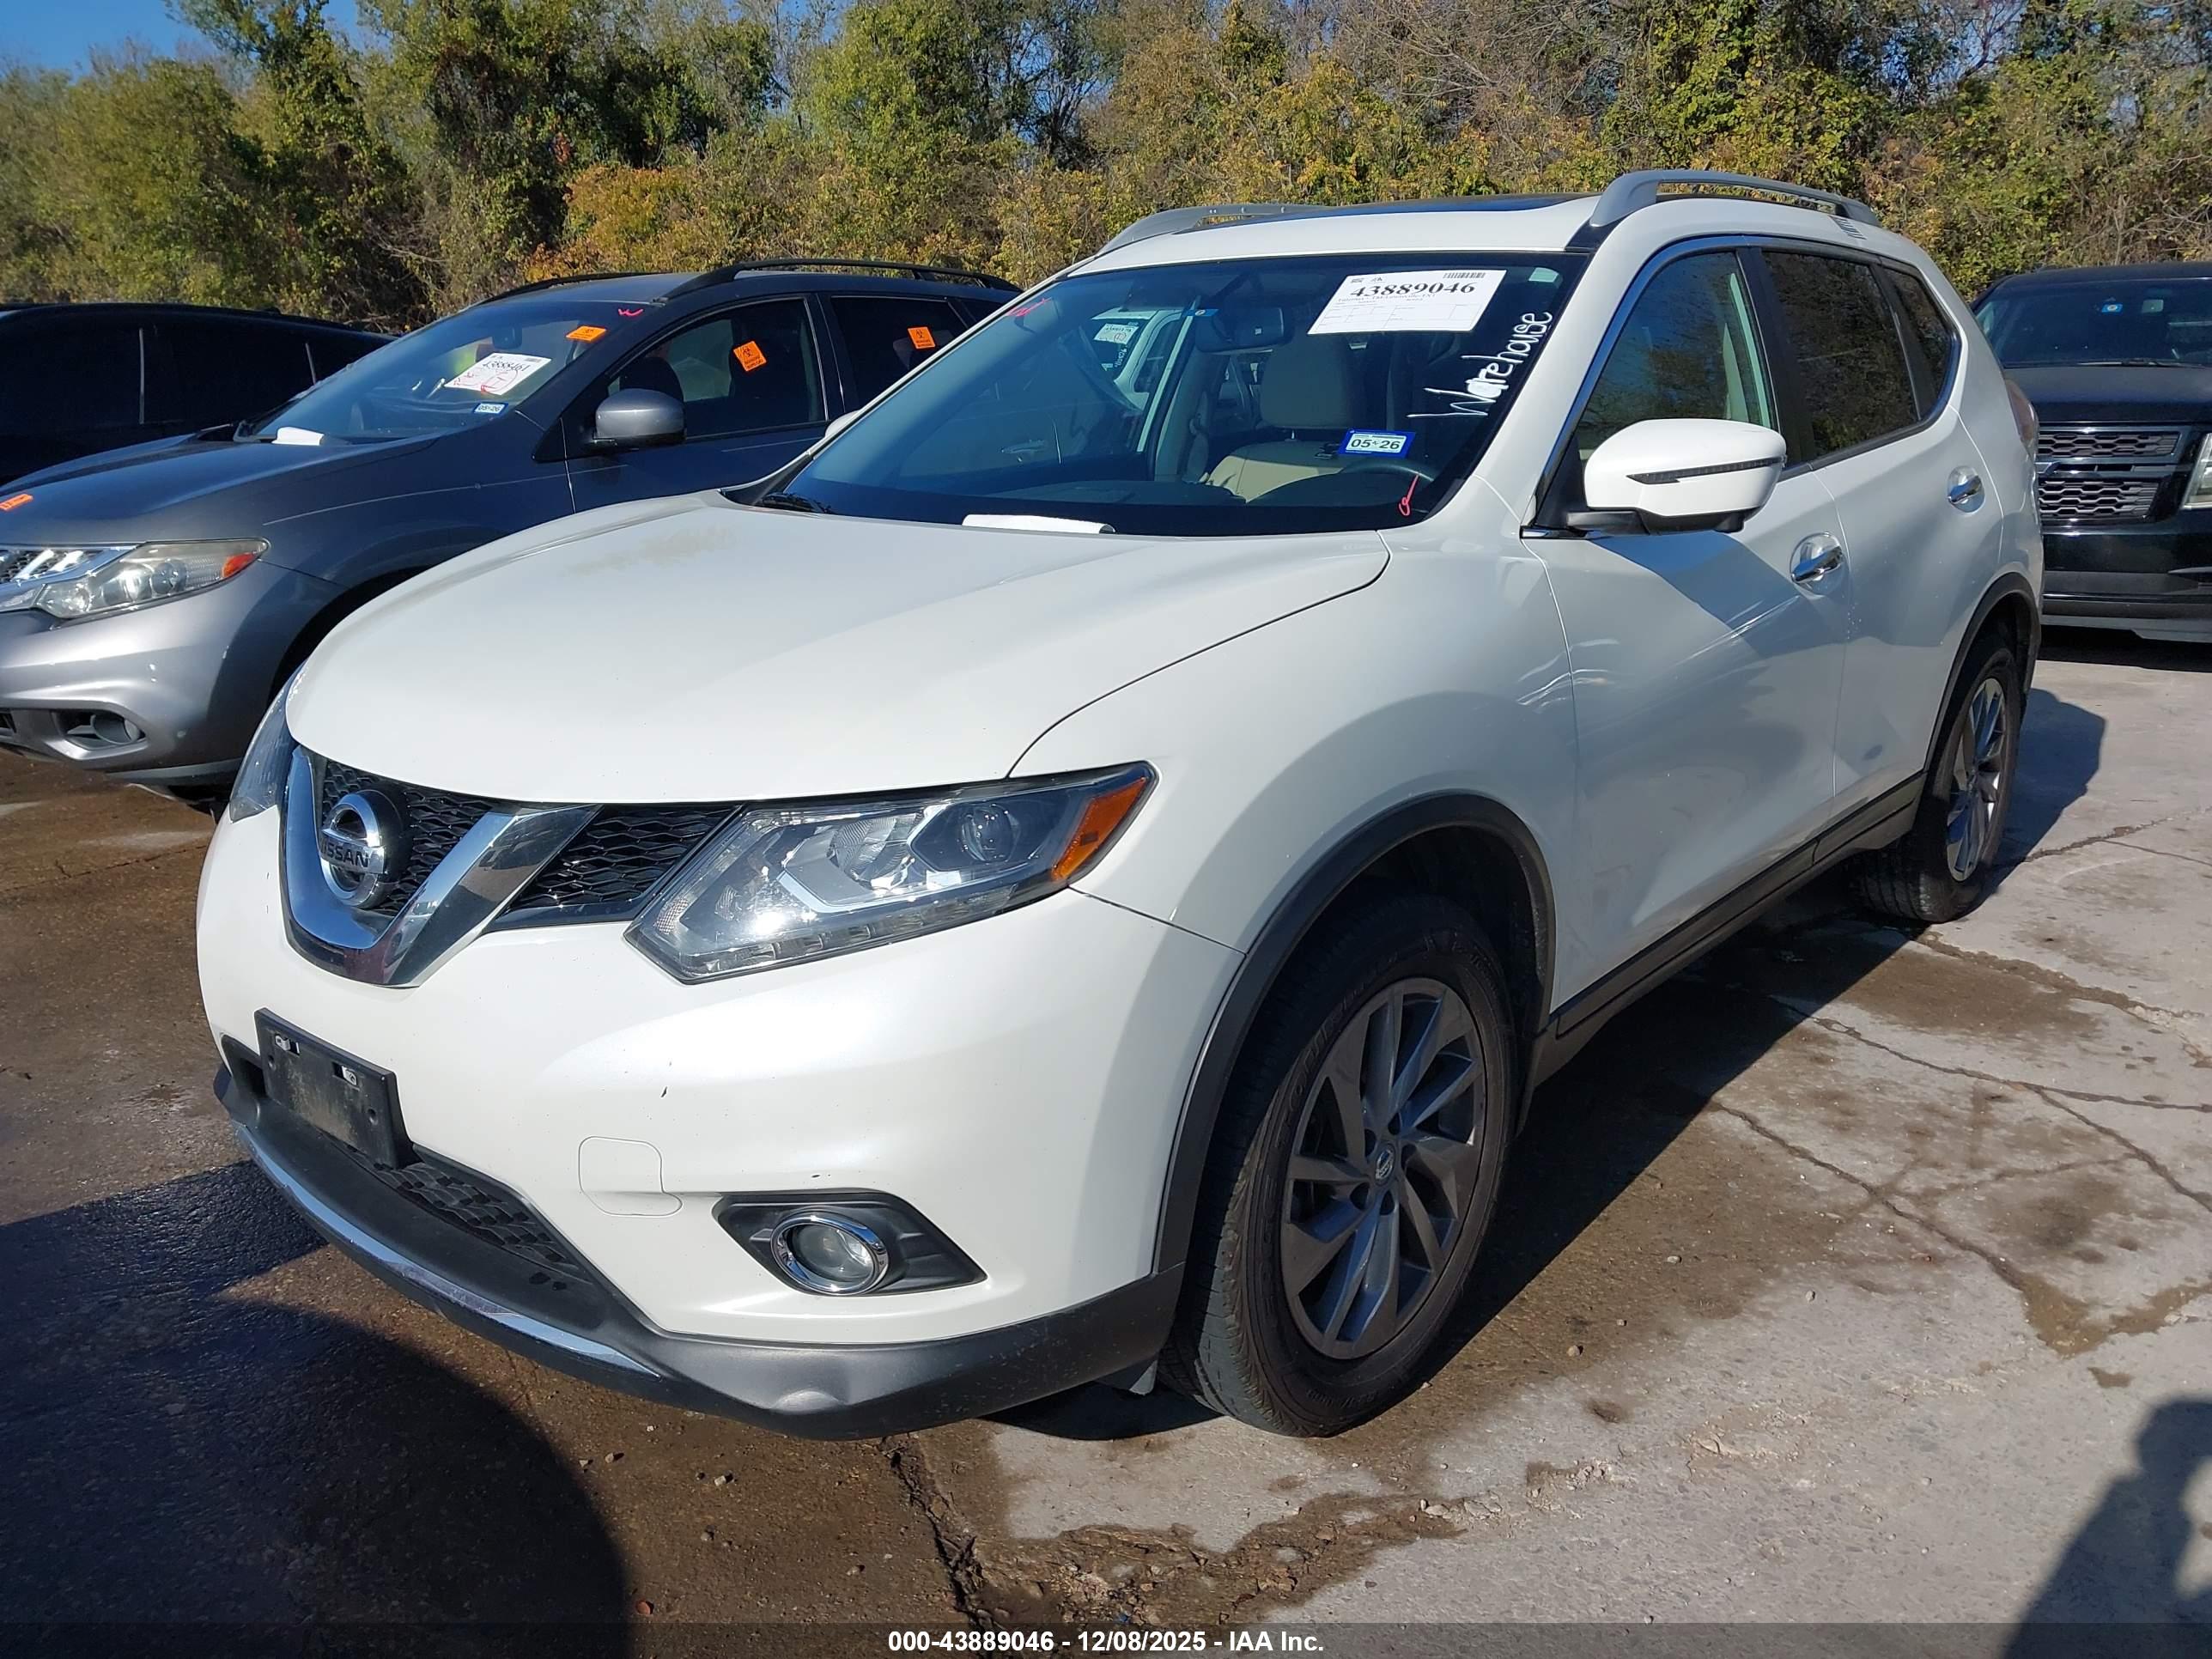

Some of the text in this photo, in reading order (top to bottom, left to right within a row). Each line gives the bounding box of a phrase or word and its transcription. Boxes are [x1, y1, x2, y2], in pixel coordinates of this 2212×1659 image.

[1349, 281, 1478, 298] 43889046
[1406, 311, 1553, 418] Warehouse
[1351, 439, 1401, 450] 05 26
